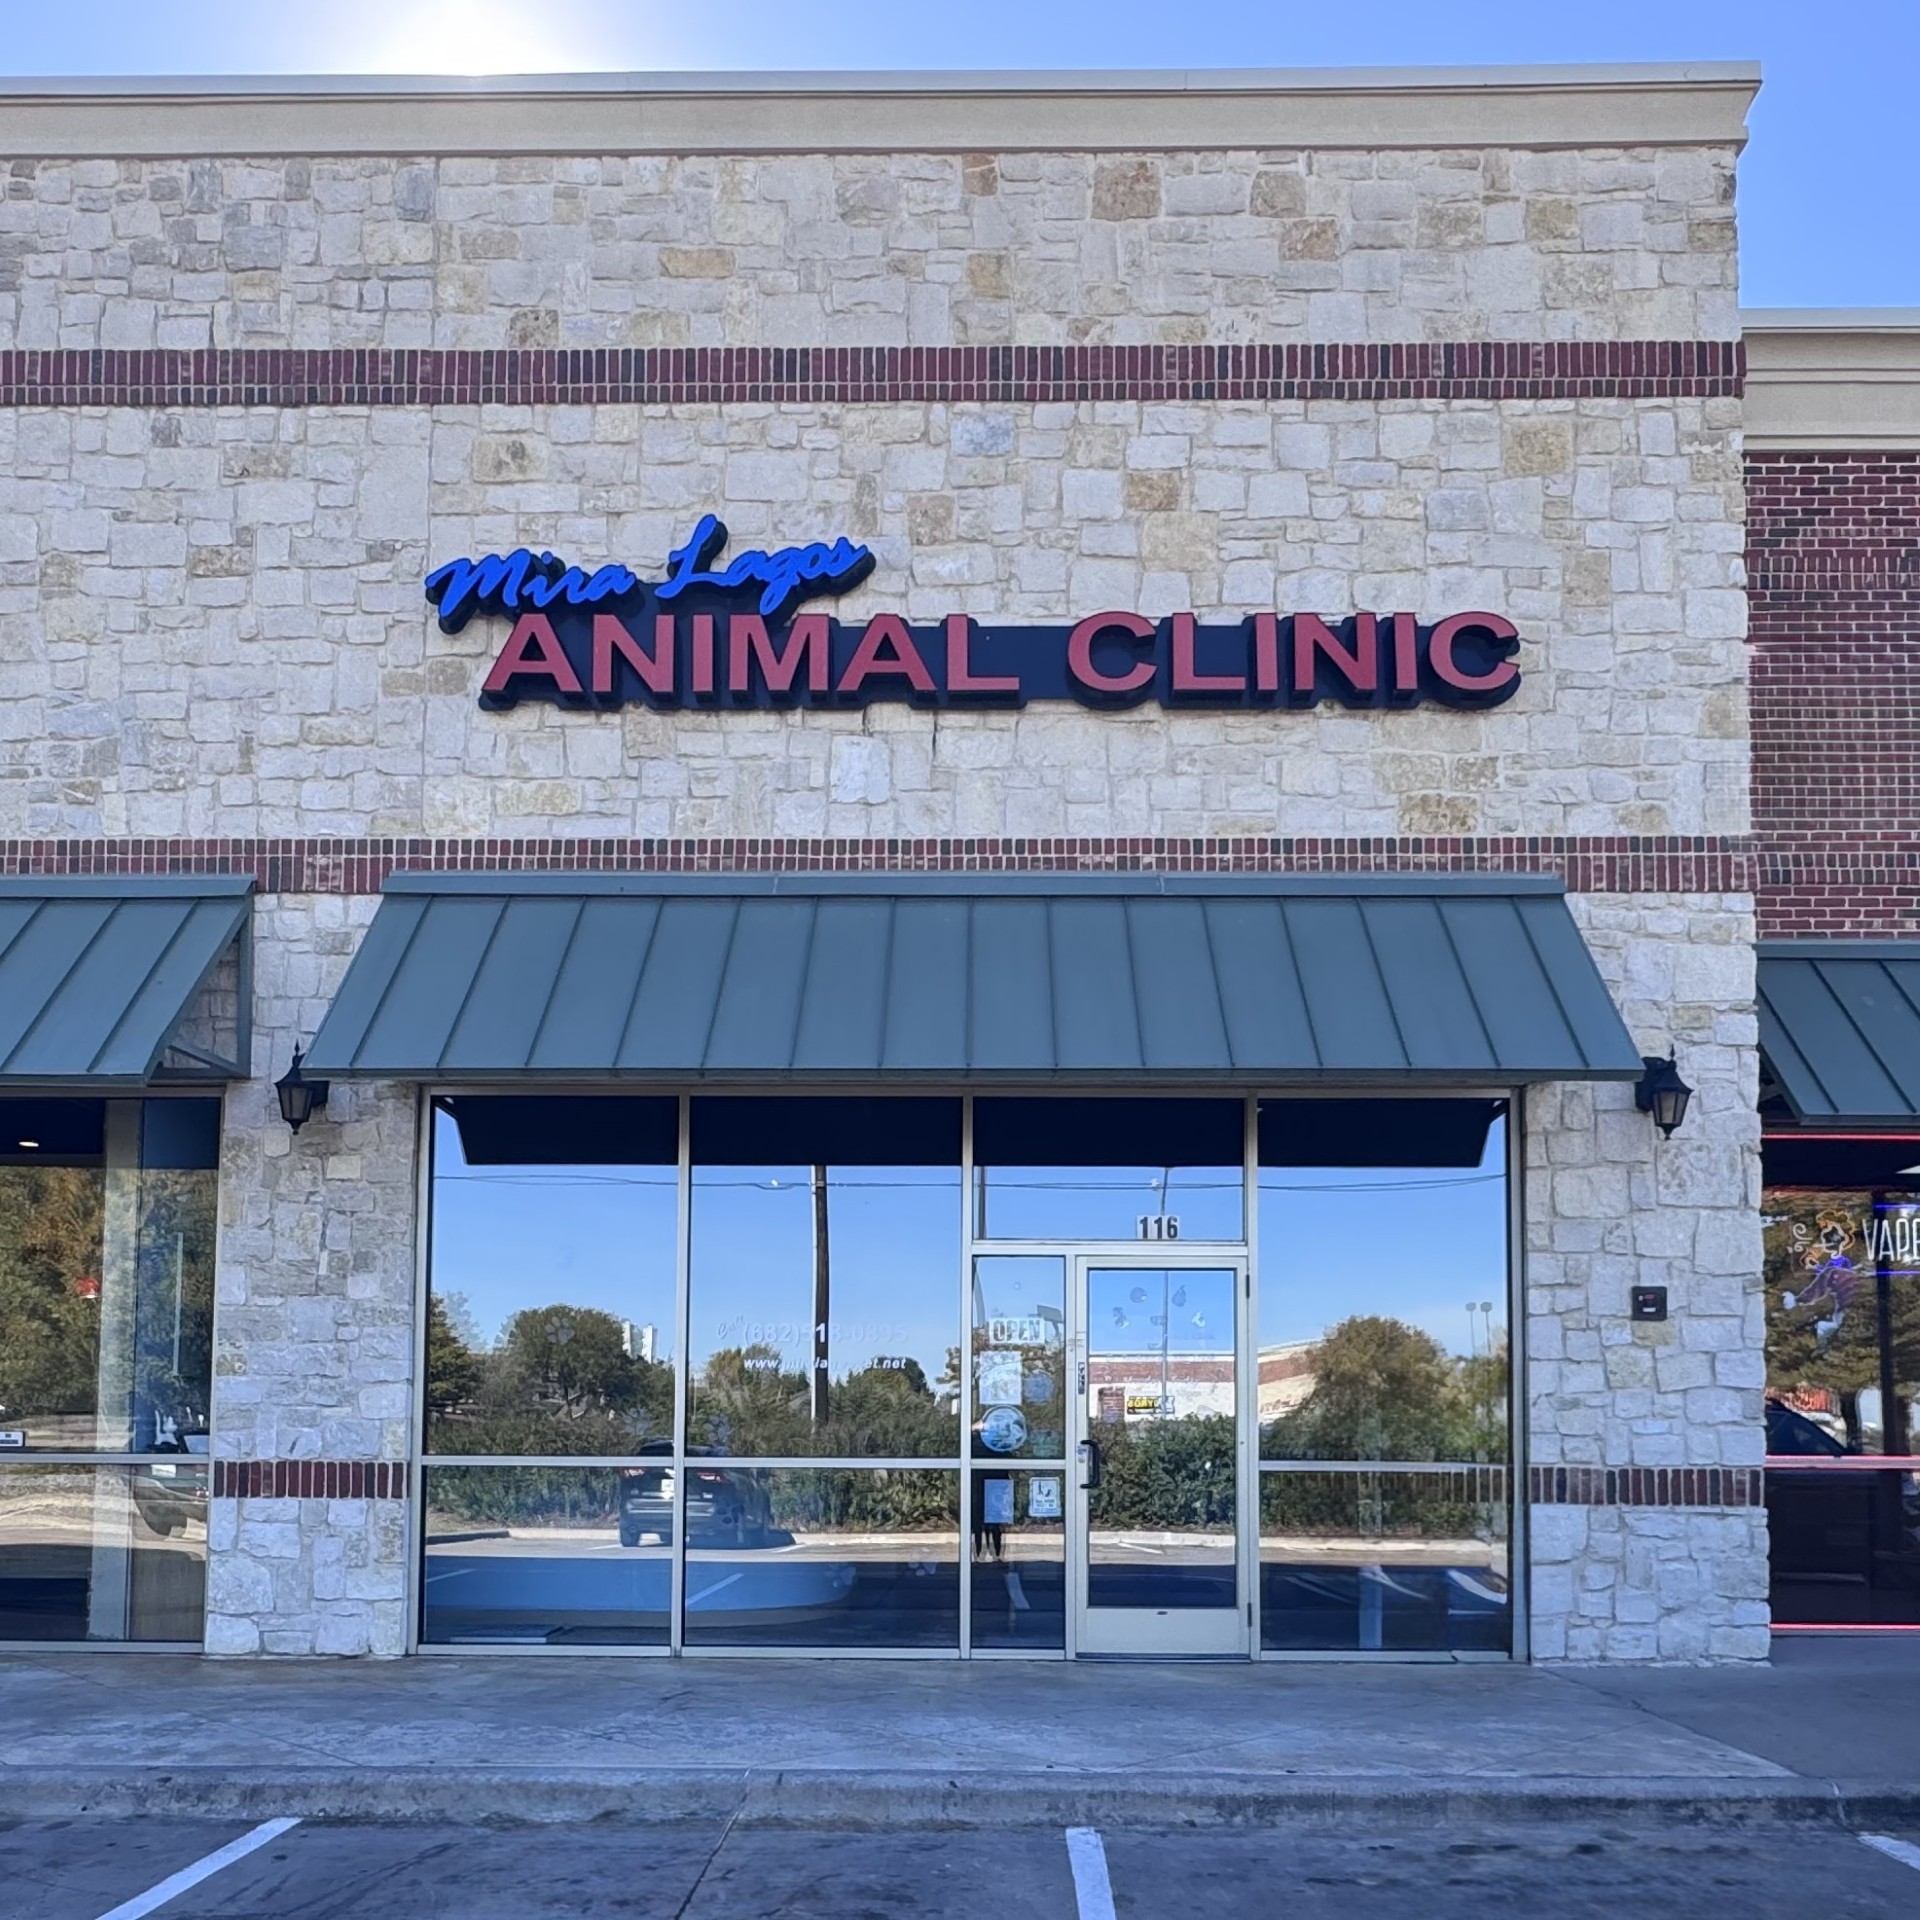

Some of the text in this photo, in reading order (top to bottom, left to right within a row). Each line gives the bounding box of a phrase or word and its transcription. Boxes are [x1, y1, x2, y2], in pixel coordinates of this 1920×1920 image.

[426, 513, 870, 618] Mira Lagos
[482, 610, 1519, 694] ANIMAL CLINIC
[1139, 1215, 1178, 1239] 116
[993, 1319, 1041, 1342] OPEN
